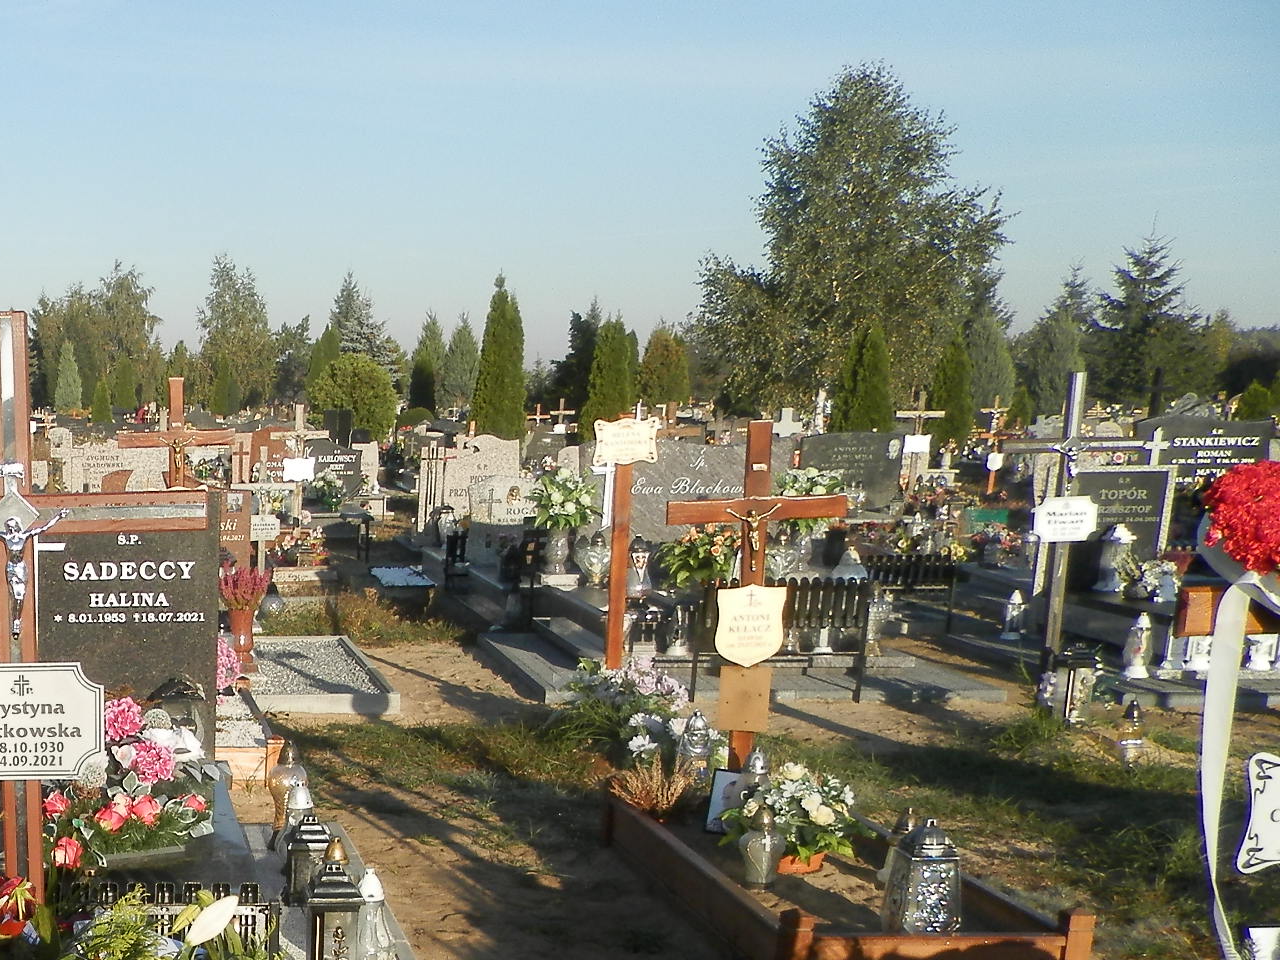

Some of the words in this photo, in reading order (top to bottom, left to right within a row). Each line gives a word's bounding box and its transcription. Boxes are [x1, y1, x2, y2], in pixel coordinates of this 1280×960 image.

[1173, 437, 1260, 446] STANKIEWICZ
[1196, 450, 1233, 458] ROMAN
[631, 476, 664, 495] Ewa
[1099, 487, 1148, 500] TOPÓR
[63, 561, 196, 581] SADECCY
[89, 592, 170, 608] HALINA
